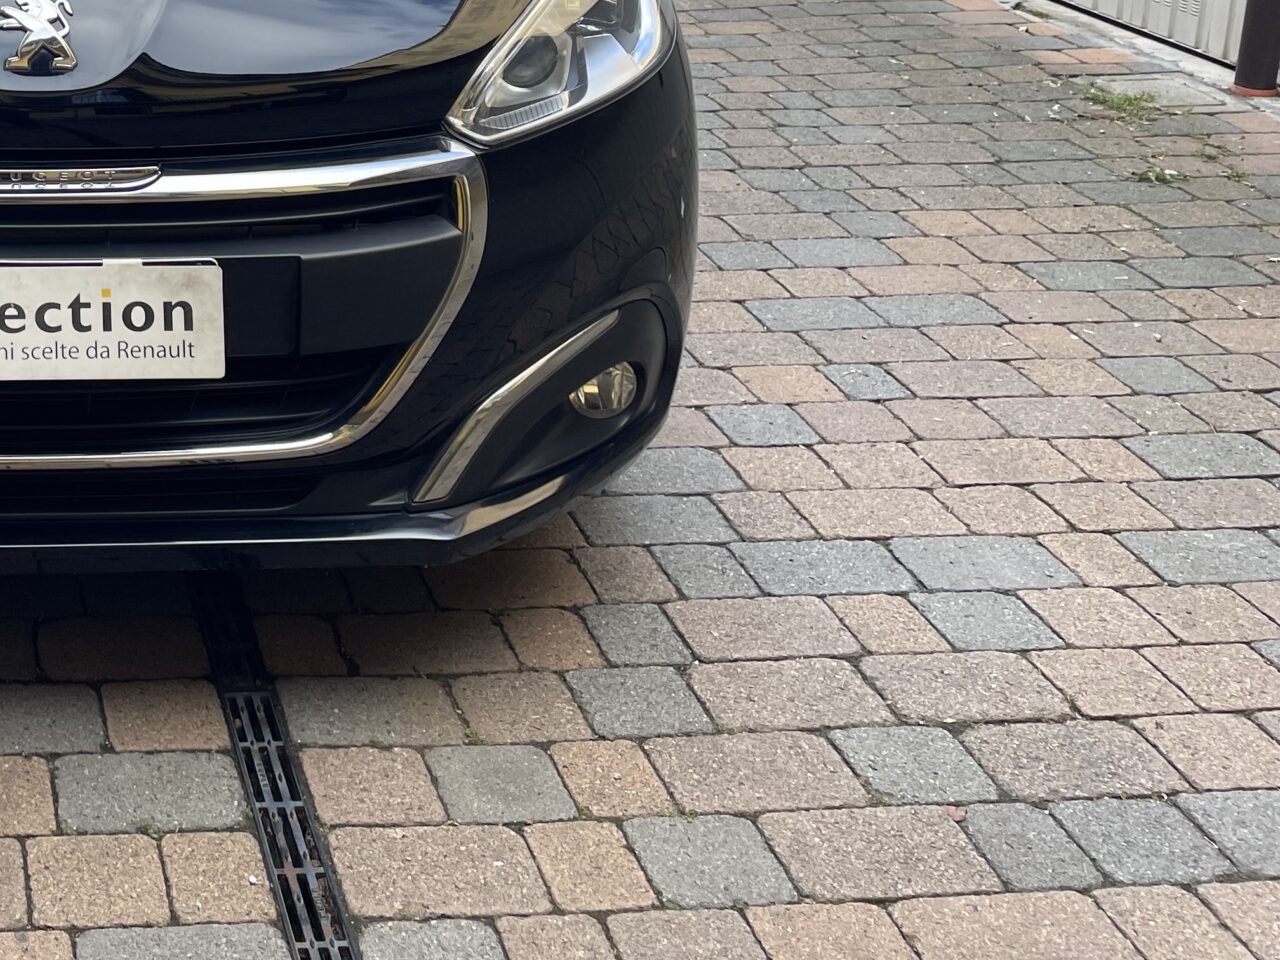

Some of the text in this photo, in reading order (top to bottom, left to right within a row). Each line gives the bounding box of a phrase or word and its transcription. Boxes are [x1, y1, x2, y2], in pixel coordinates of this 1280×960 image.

[21, 341, 80, 360] scelte
[86, 340, 110, 360] da
[117, 339, 195, 359] Renault
